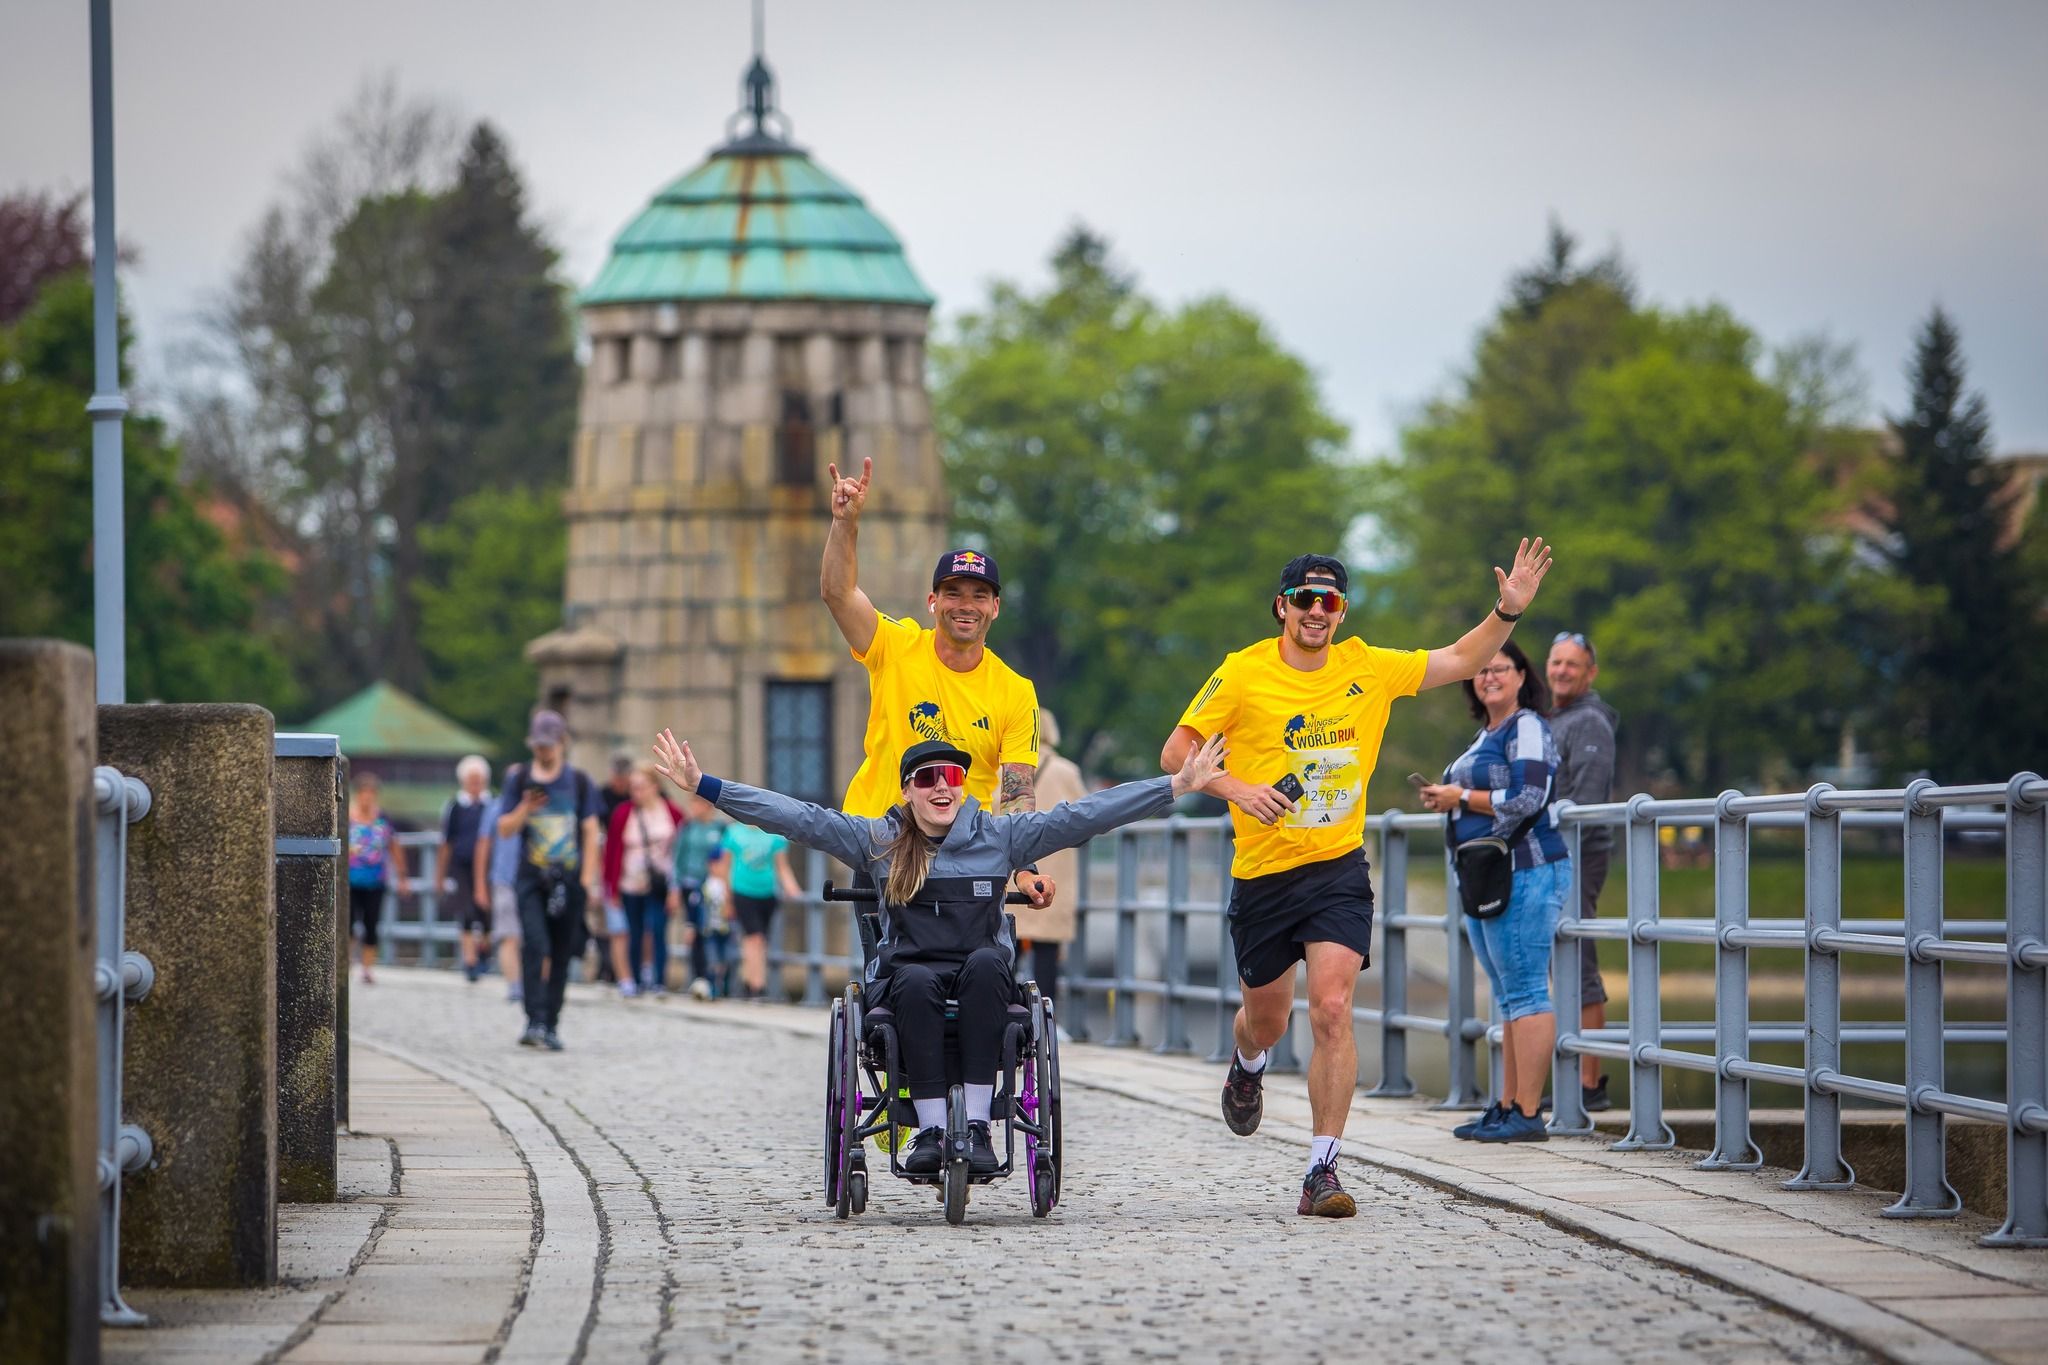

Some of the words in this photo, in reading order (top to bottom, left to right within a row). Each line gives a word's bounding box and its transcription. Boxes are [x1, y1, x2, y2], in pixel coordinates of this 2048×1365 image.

[952, 563, 969, 572] Red
[970, 564, 985, 575] Bull
[916, 720, 943, 741] WOR
[1305, 719, 1333, 729] WINGS
[1297, 731, 1337, 749] WORLD
[1304, 789, 1348, 802] 127675
